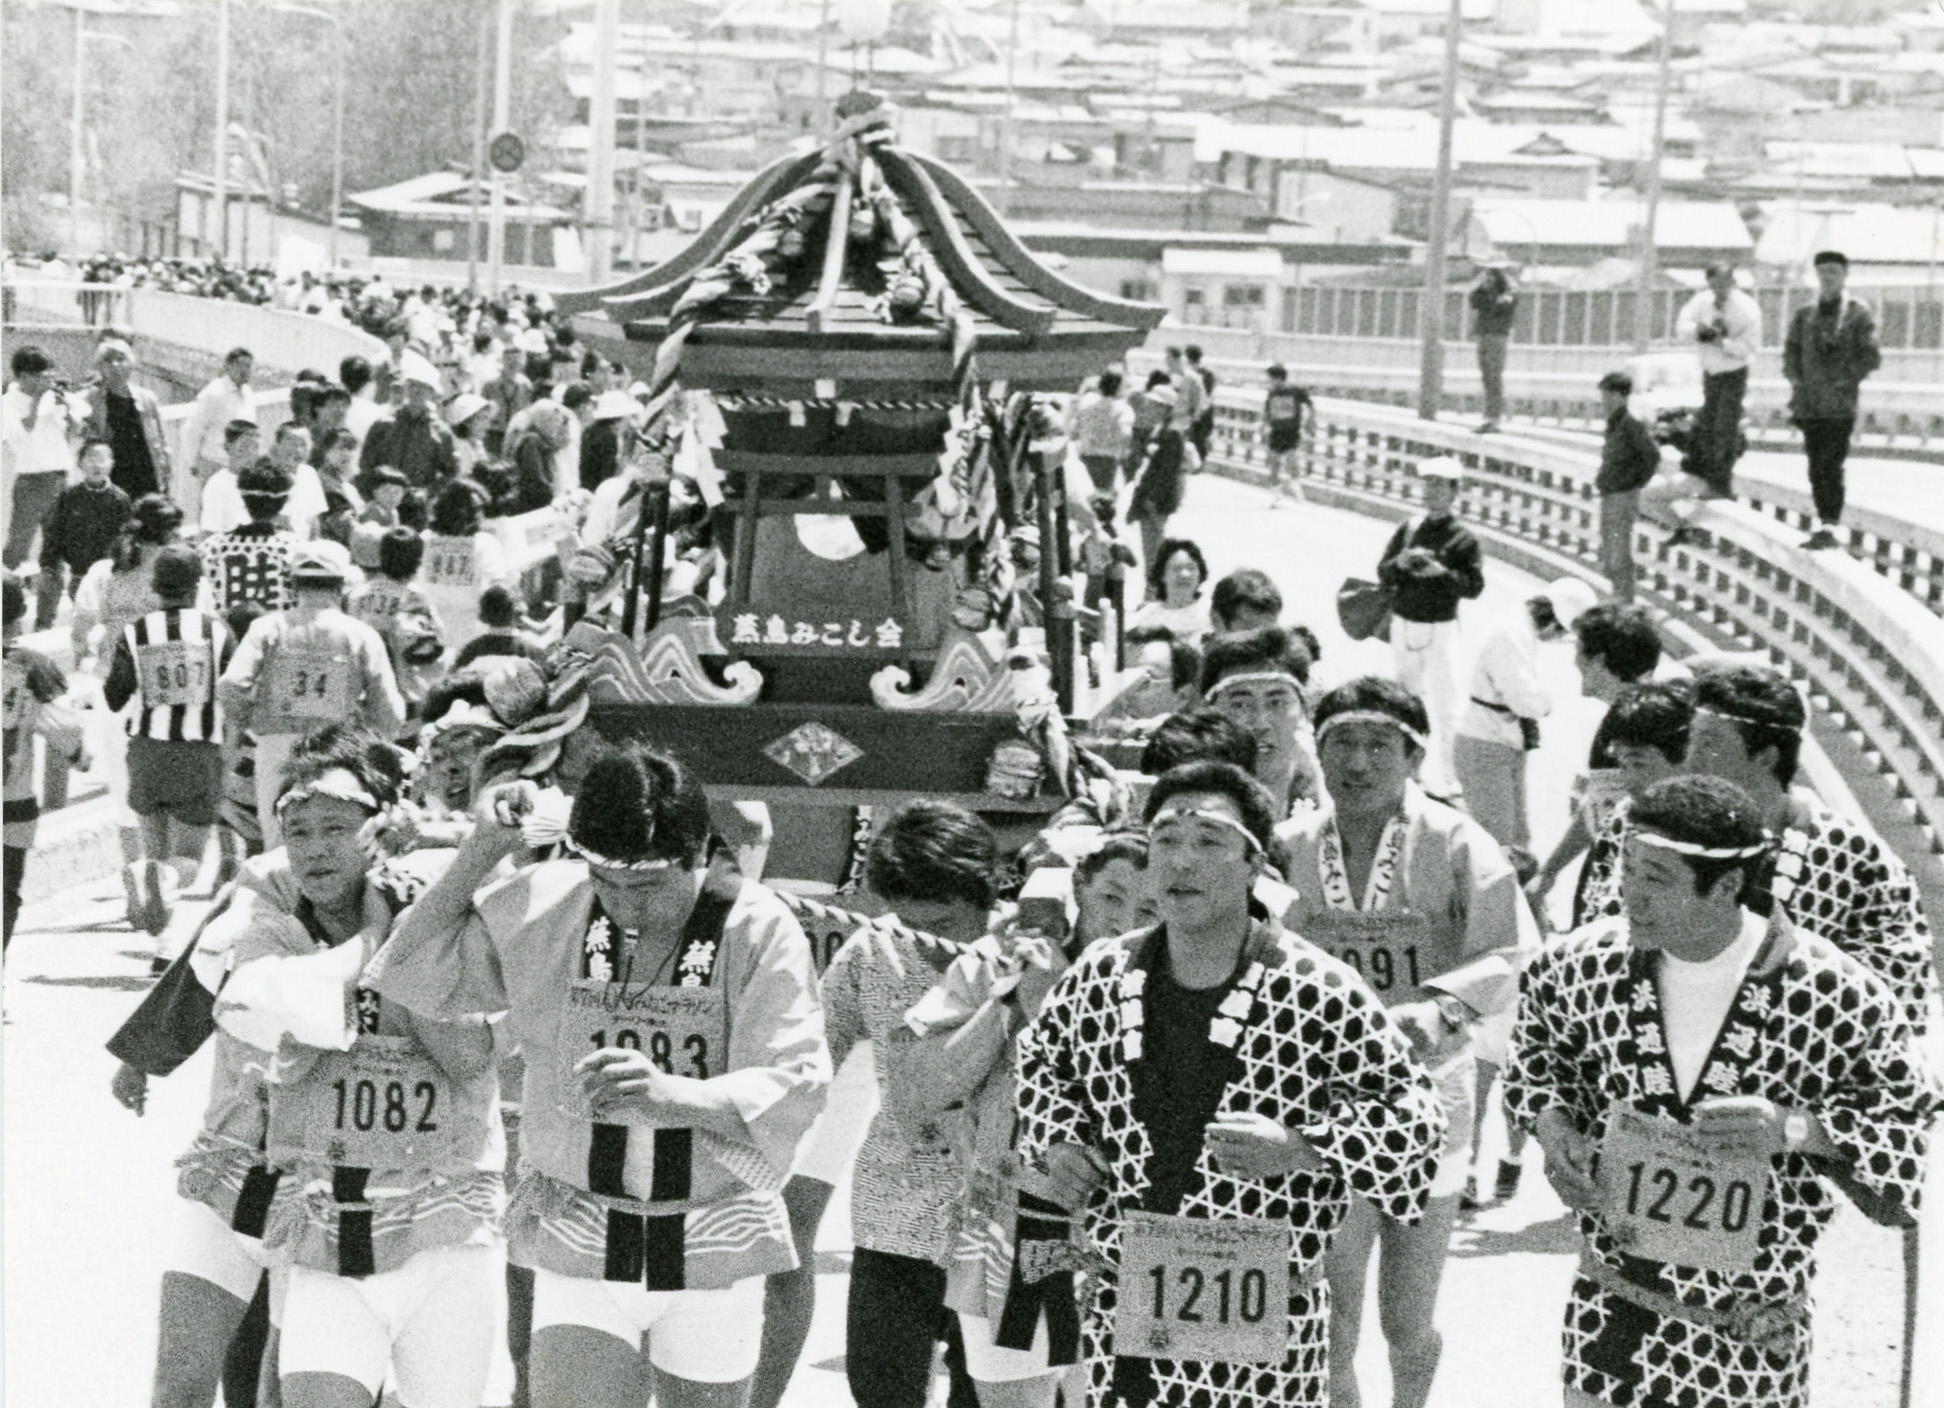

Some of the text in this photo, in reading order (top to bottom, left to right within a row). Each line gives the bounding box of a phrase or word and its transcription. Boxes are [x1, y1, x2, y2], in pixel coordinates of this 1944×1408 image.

[293, 670, 328, 699] 34
[1324, 945, 1419, 991] 91
[332, 1079, 438, 1133] 1082
[1626, 1160, 1752, 1233] 1220
[1148, 1264, 1267, 1325] 1210
